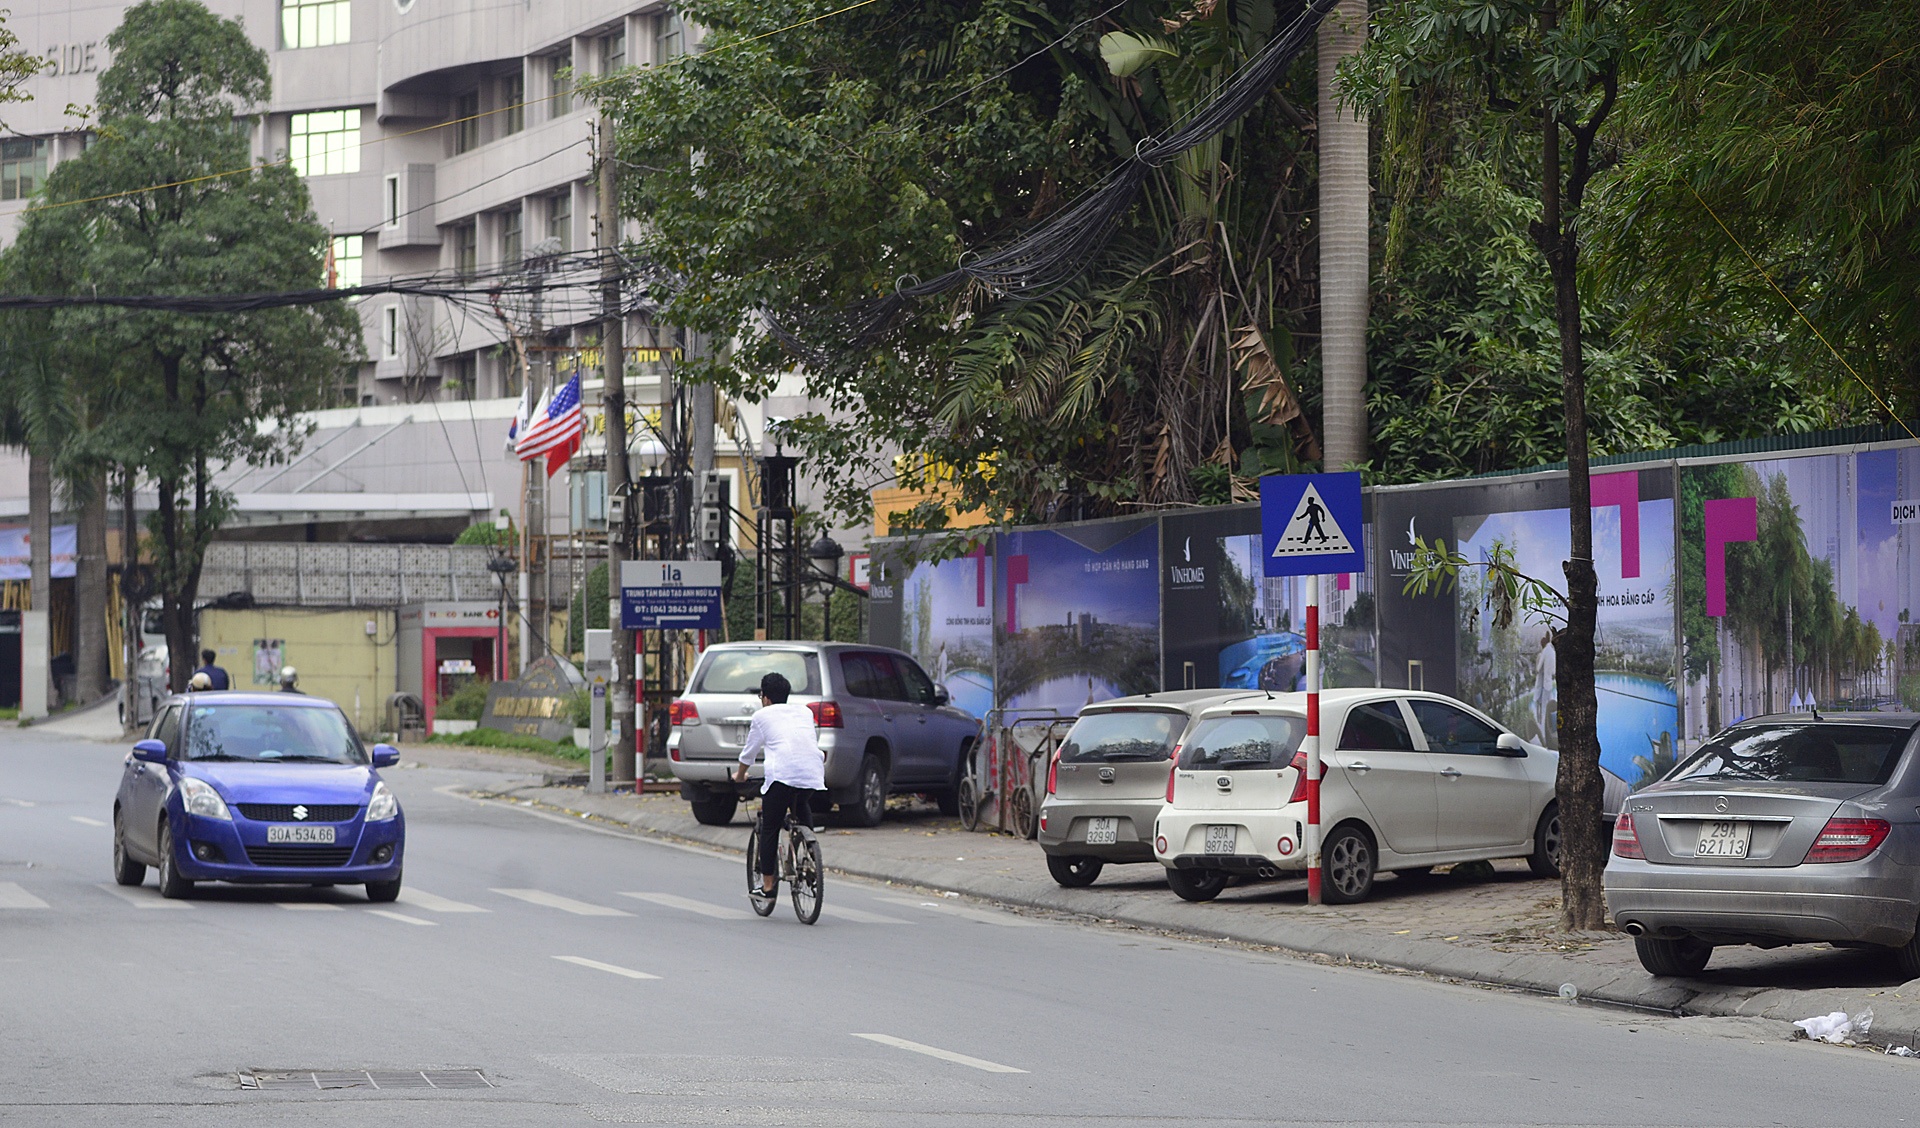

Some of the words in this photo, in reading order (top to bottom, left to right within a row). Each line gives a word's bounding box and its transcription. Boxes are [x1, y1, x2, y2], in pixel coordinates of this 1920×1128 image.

[46, 42, 97, 77] SIDE
[1893, 505, 1916, 524] DỊCH
[662, 564, 682, 581] ila
[1171, 566, 1205, 584] VINHOMES
[626, 589, 645, 598] TRUNG
[645, 587, 658, 598] TÂM
[683, 588, 695, 597] ANH
[708, 589, 718, 597] ILA
[1606, 595, 1620, 606] HOA
[1641, 588, 1655, 605] CẤP
[650, 605, 666, 614] (04)
[668, 605, 687, 613] 3843
[688, 605, 708, 613] 6888
[1095, 818, 1111, 830] 30A
[1711, 822, 1736, 838] 29A
[1087, 830, 1116, 843] 329.90
[1212, 827, 1228, 839] 30A
[1205, 839, 1234, 853] 987.69
[1698, 839, 1745, 855] 621.13
